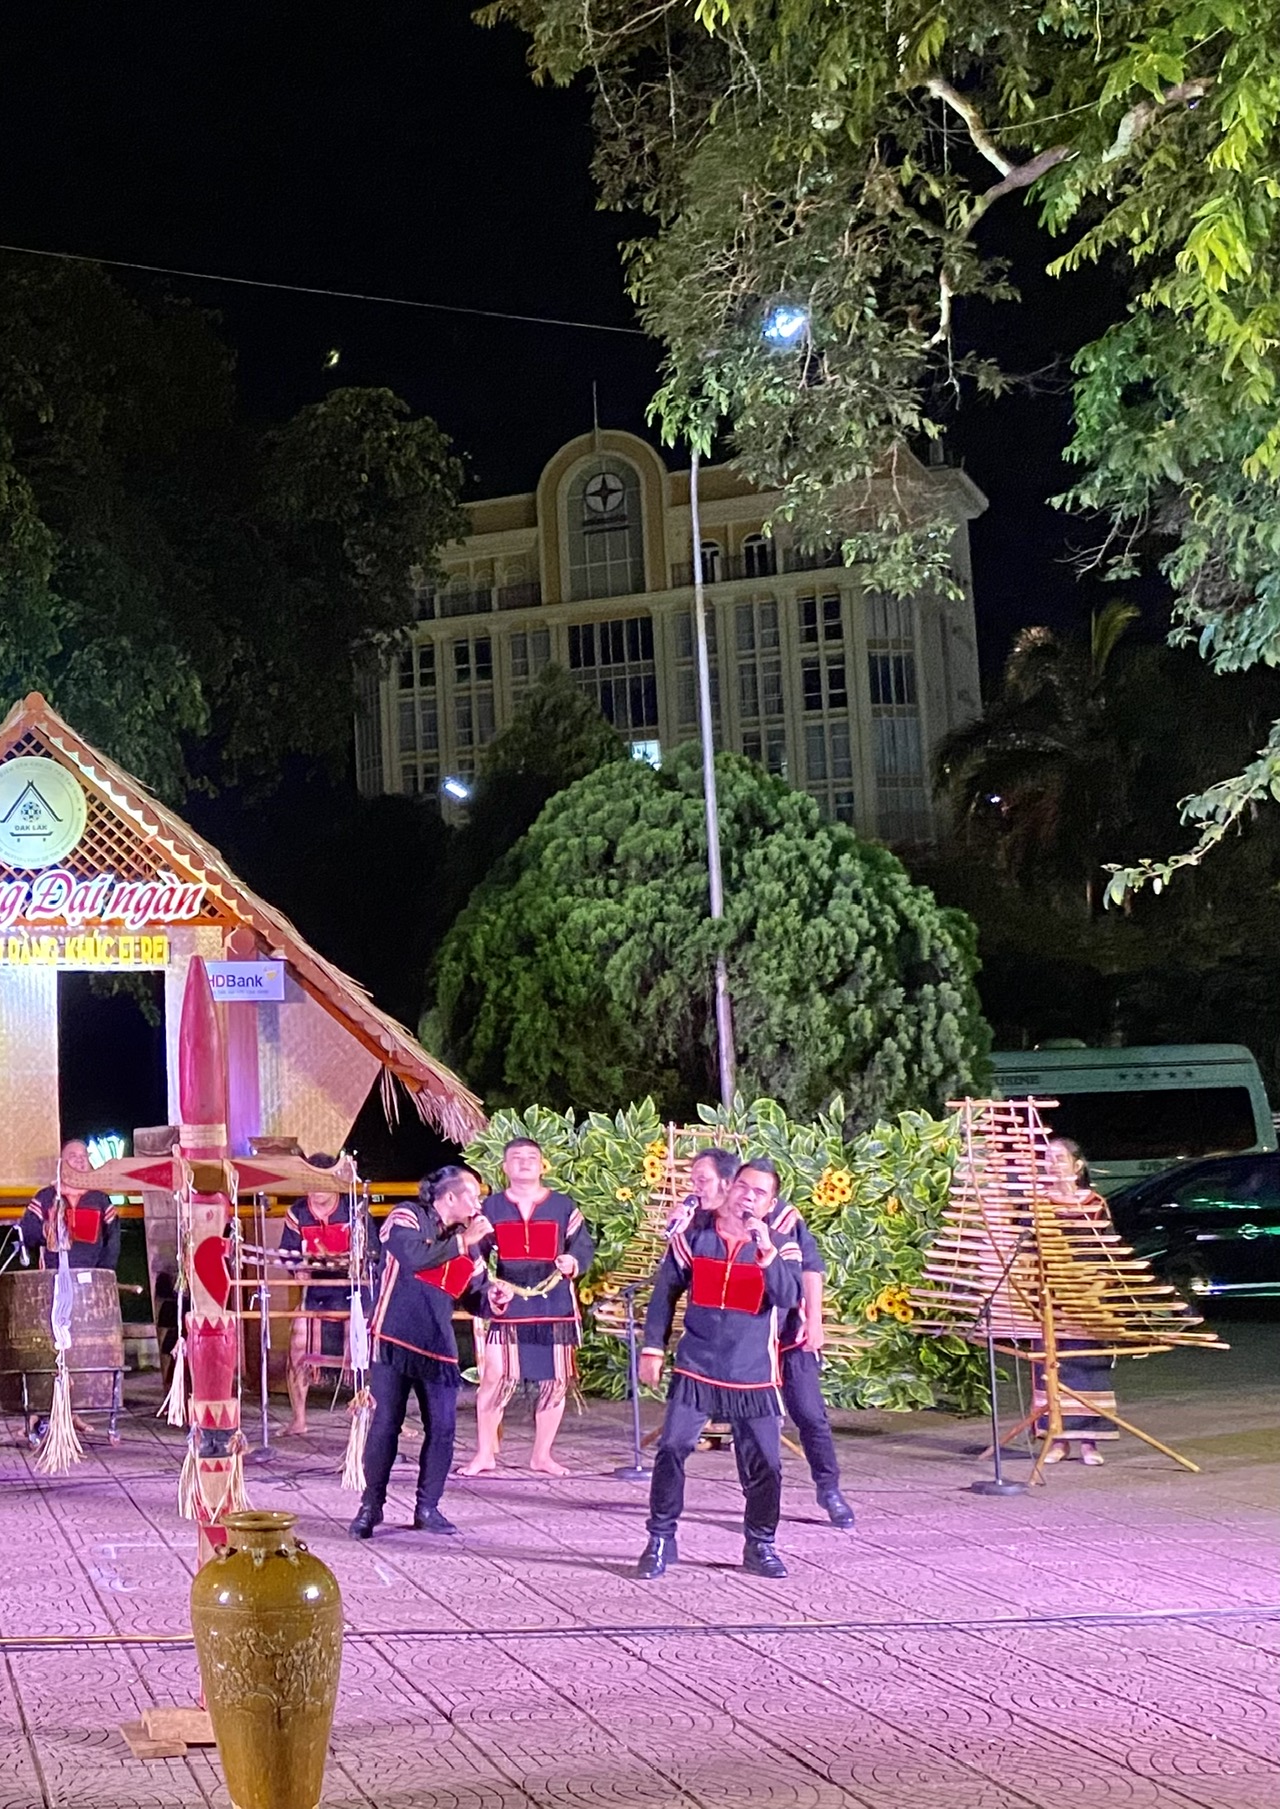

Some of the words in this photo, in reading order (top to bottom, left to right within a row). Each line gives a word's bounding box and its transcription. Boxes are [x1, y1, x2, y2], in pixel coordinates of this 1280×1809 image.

[26, 869, 114, 926] Đại
[102, 870, 207, 930] ngàn
[65, 929, 115, 965] KHÚC
